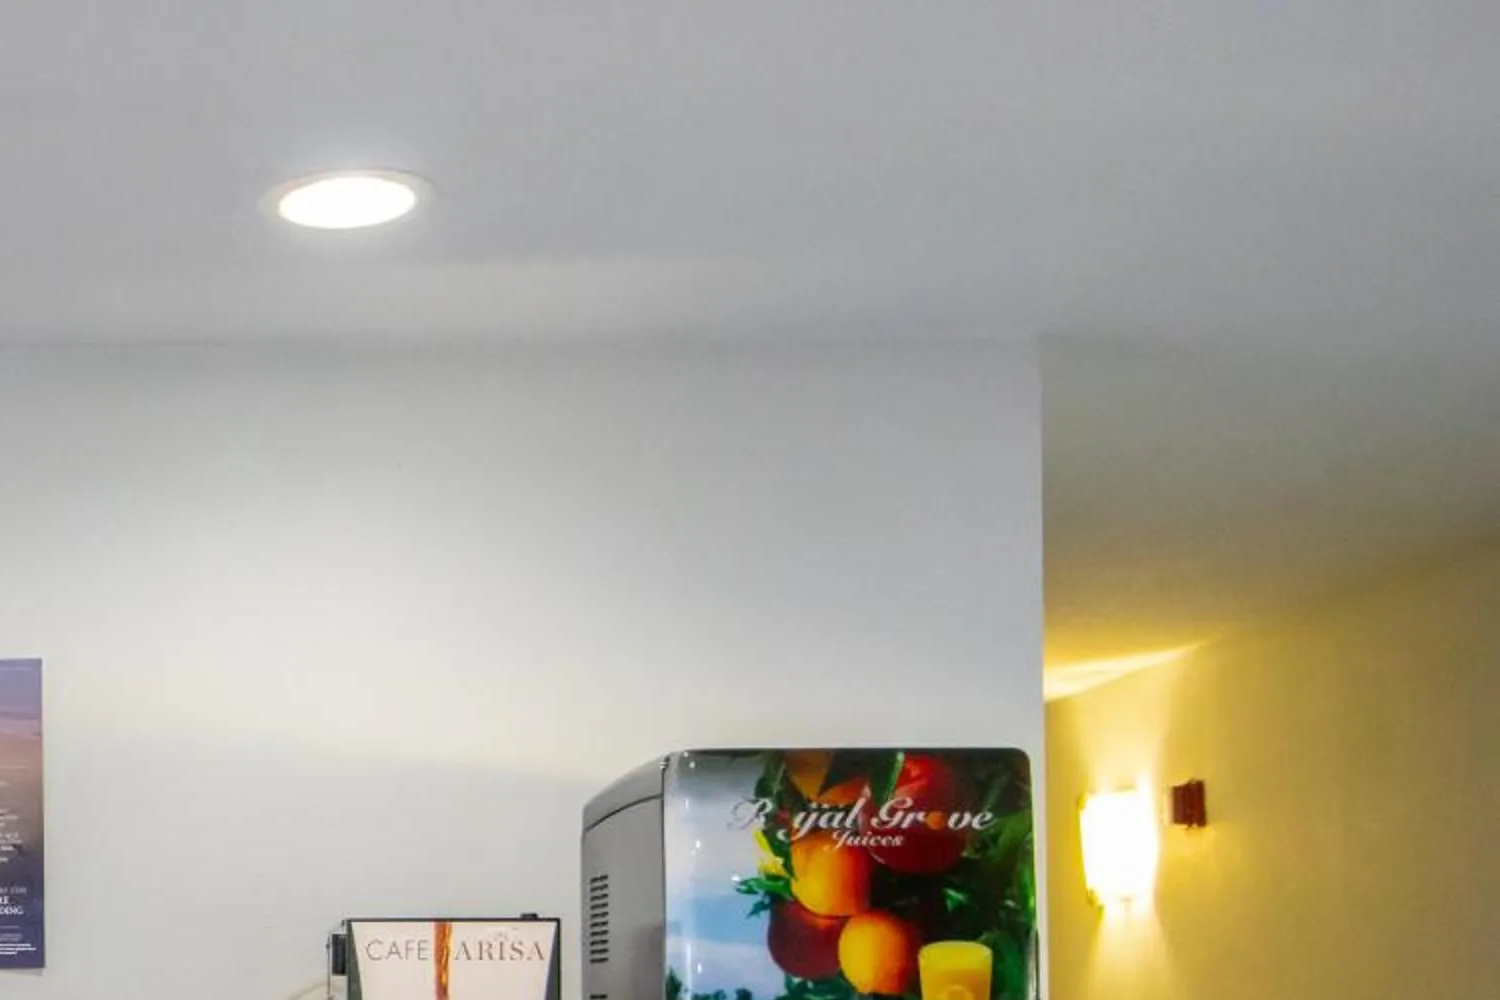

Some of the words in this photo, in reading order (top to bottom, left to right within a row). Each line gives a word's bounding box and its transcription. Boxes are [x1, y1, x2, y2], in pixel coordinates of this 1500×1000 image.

[828, 830, 905, 850] Juices
[365, 938, 430, 961] CAFE
[454, 939, 545, 961] ARISA
